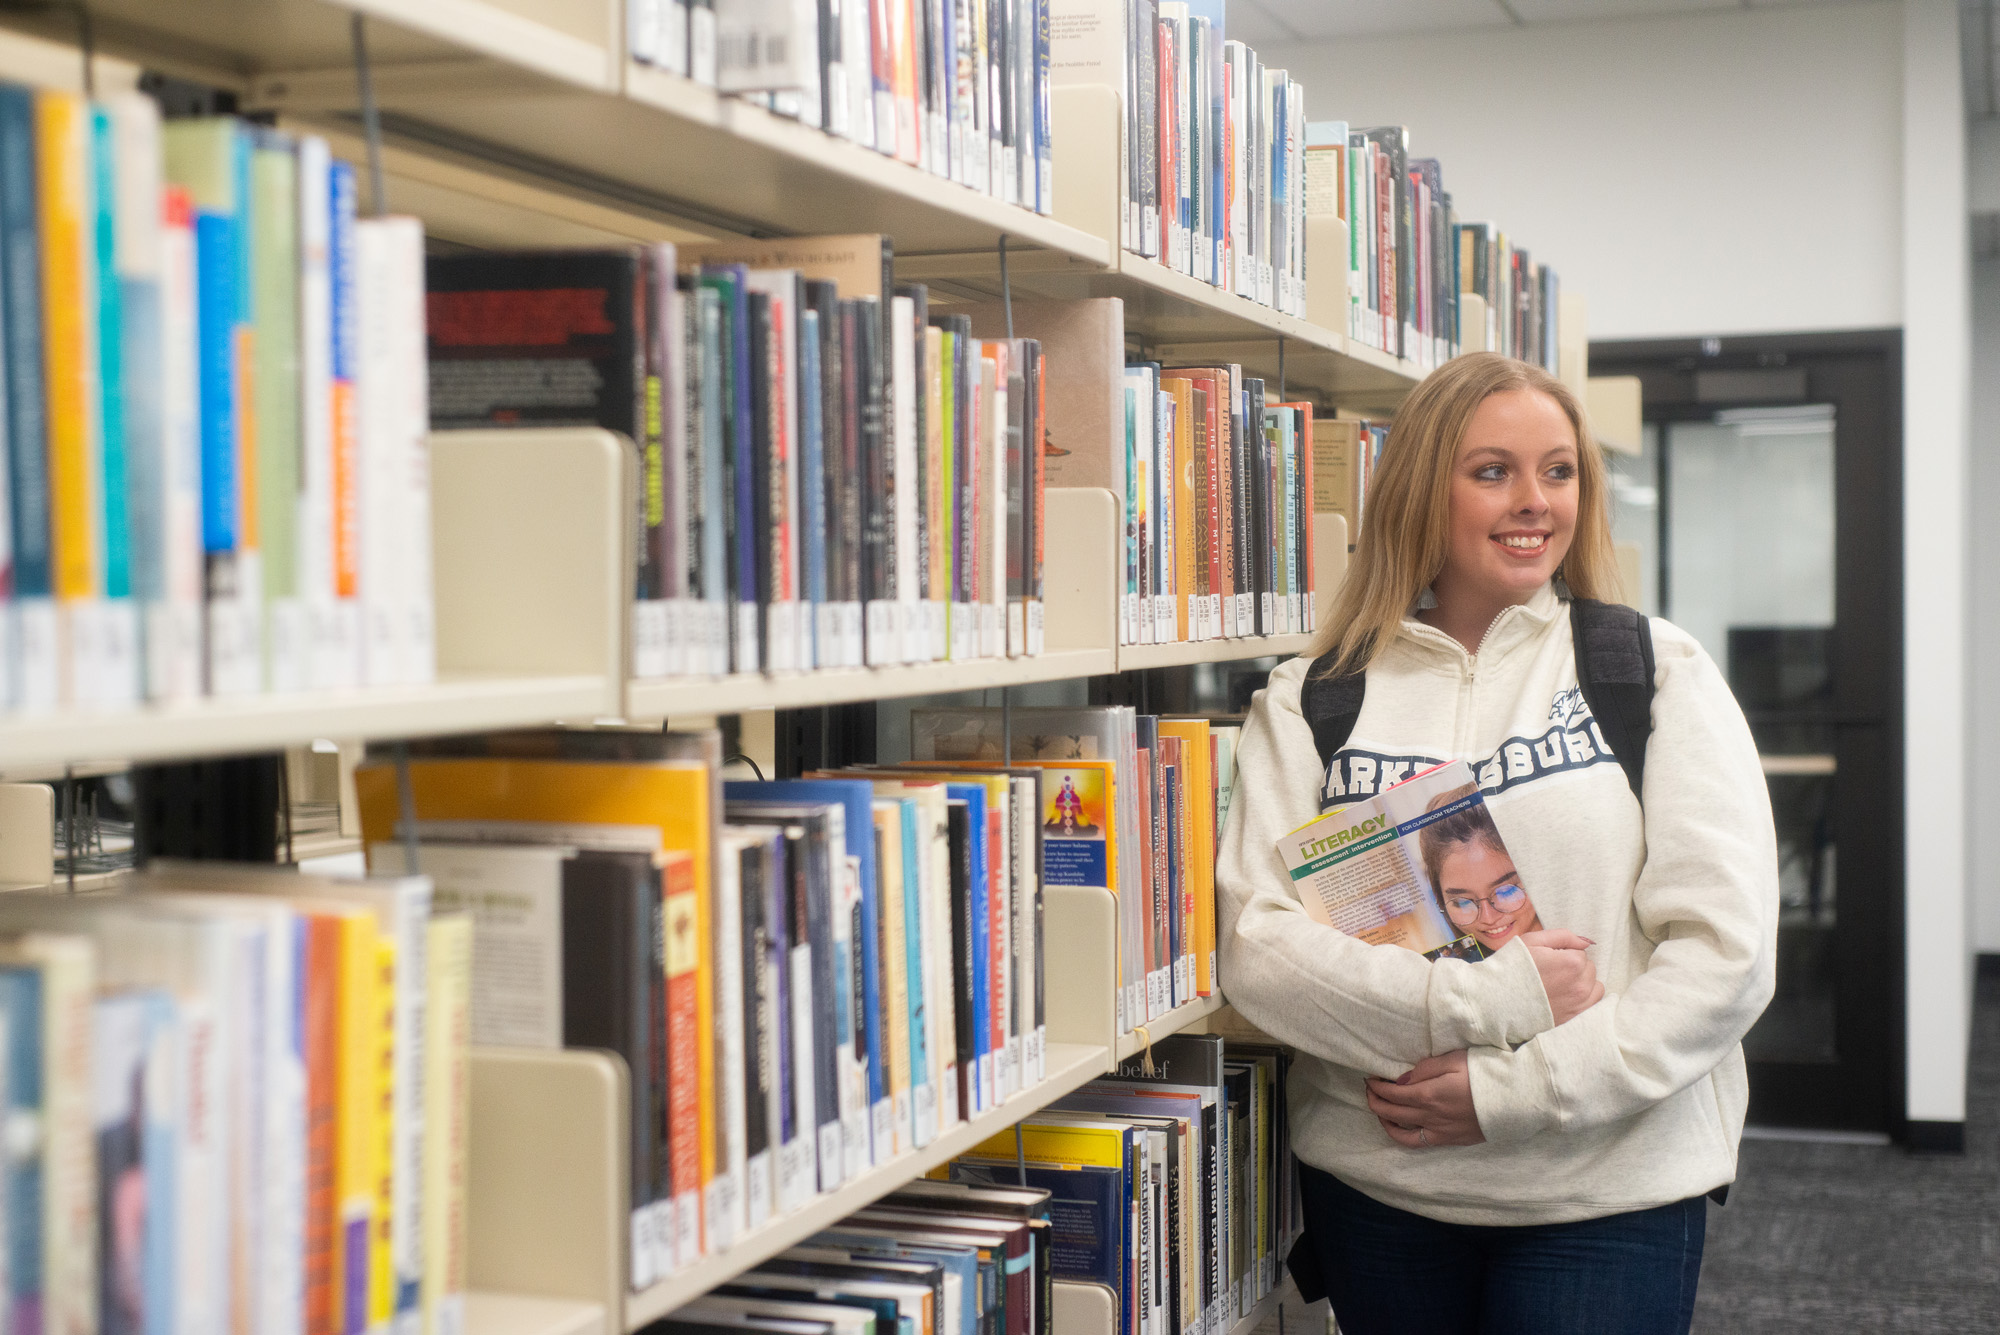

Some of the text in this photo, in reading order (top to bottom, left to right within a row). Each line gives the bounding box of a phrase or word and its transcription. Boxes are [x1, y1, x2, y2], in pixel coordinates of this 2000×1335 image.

[1143, 35, 1152, 103] GREEK
[1224, 440, 1232, 512] LEGENDS
[1287, 453, 1295, 486] HINDU
[1226, 517, 1232, 536] OF
[1300, 812, 1386, 860] LITERACY
[1401, 799, 1471, 832] FOR CLASSROOM TEACHERS
[1311, 832, 1393, 870] assessment intervention
[995, 868, 1005, 1031] THE EVIL WITHIN
[1012, 914, 1020, 956] MIND
[1141, 1169, 1149, 1246] RELIGIOUS
